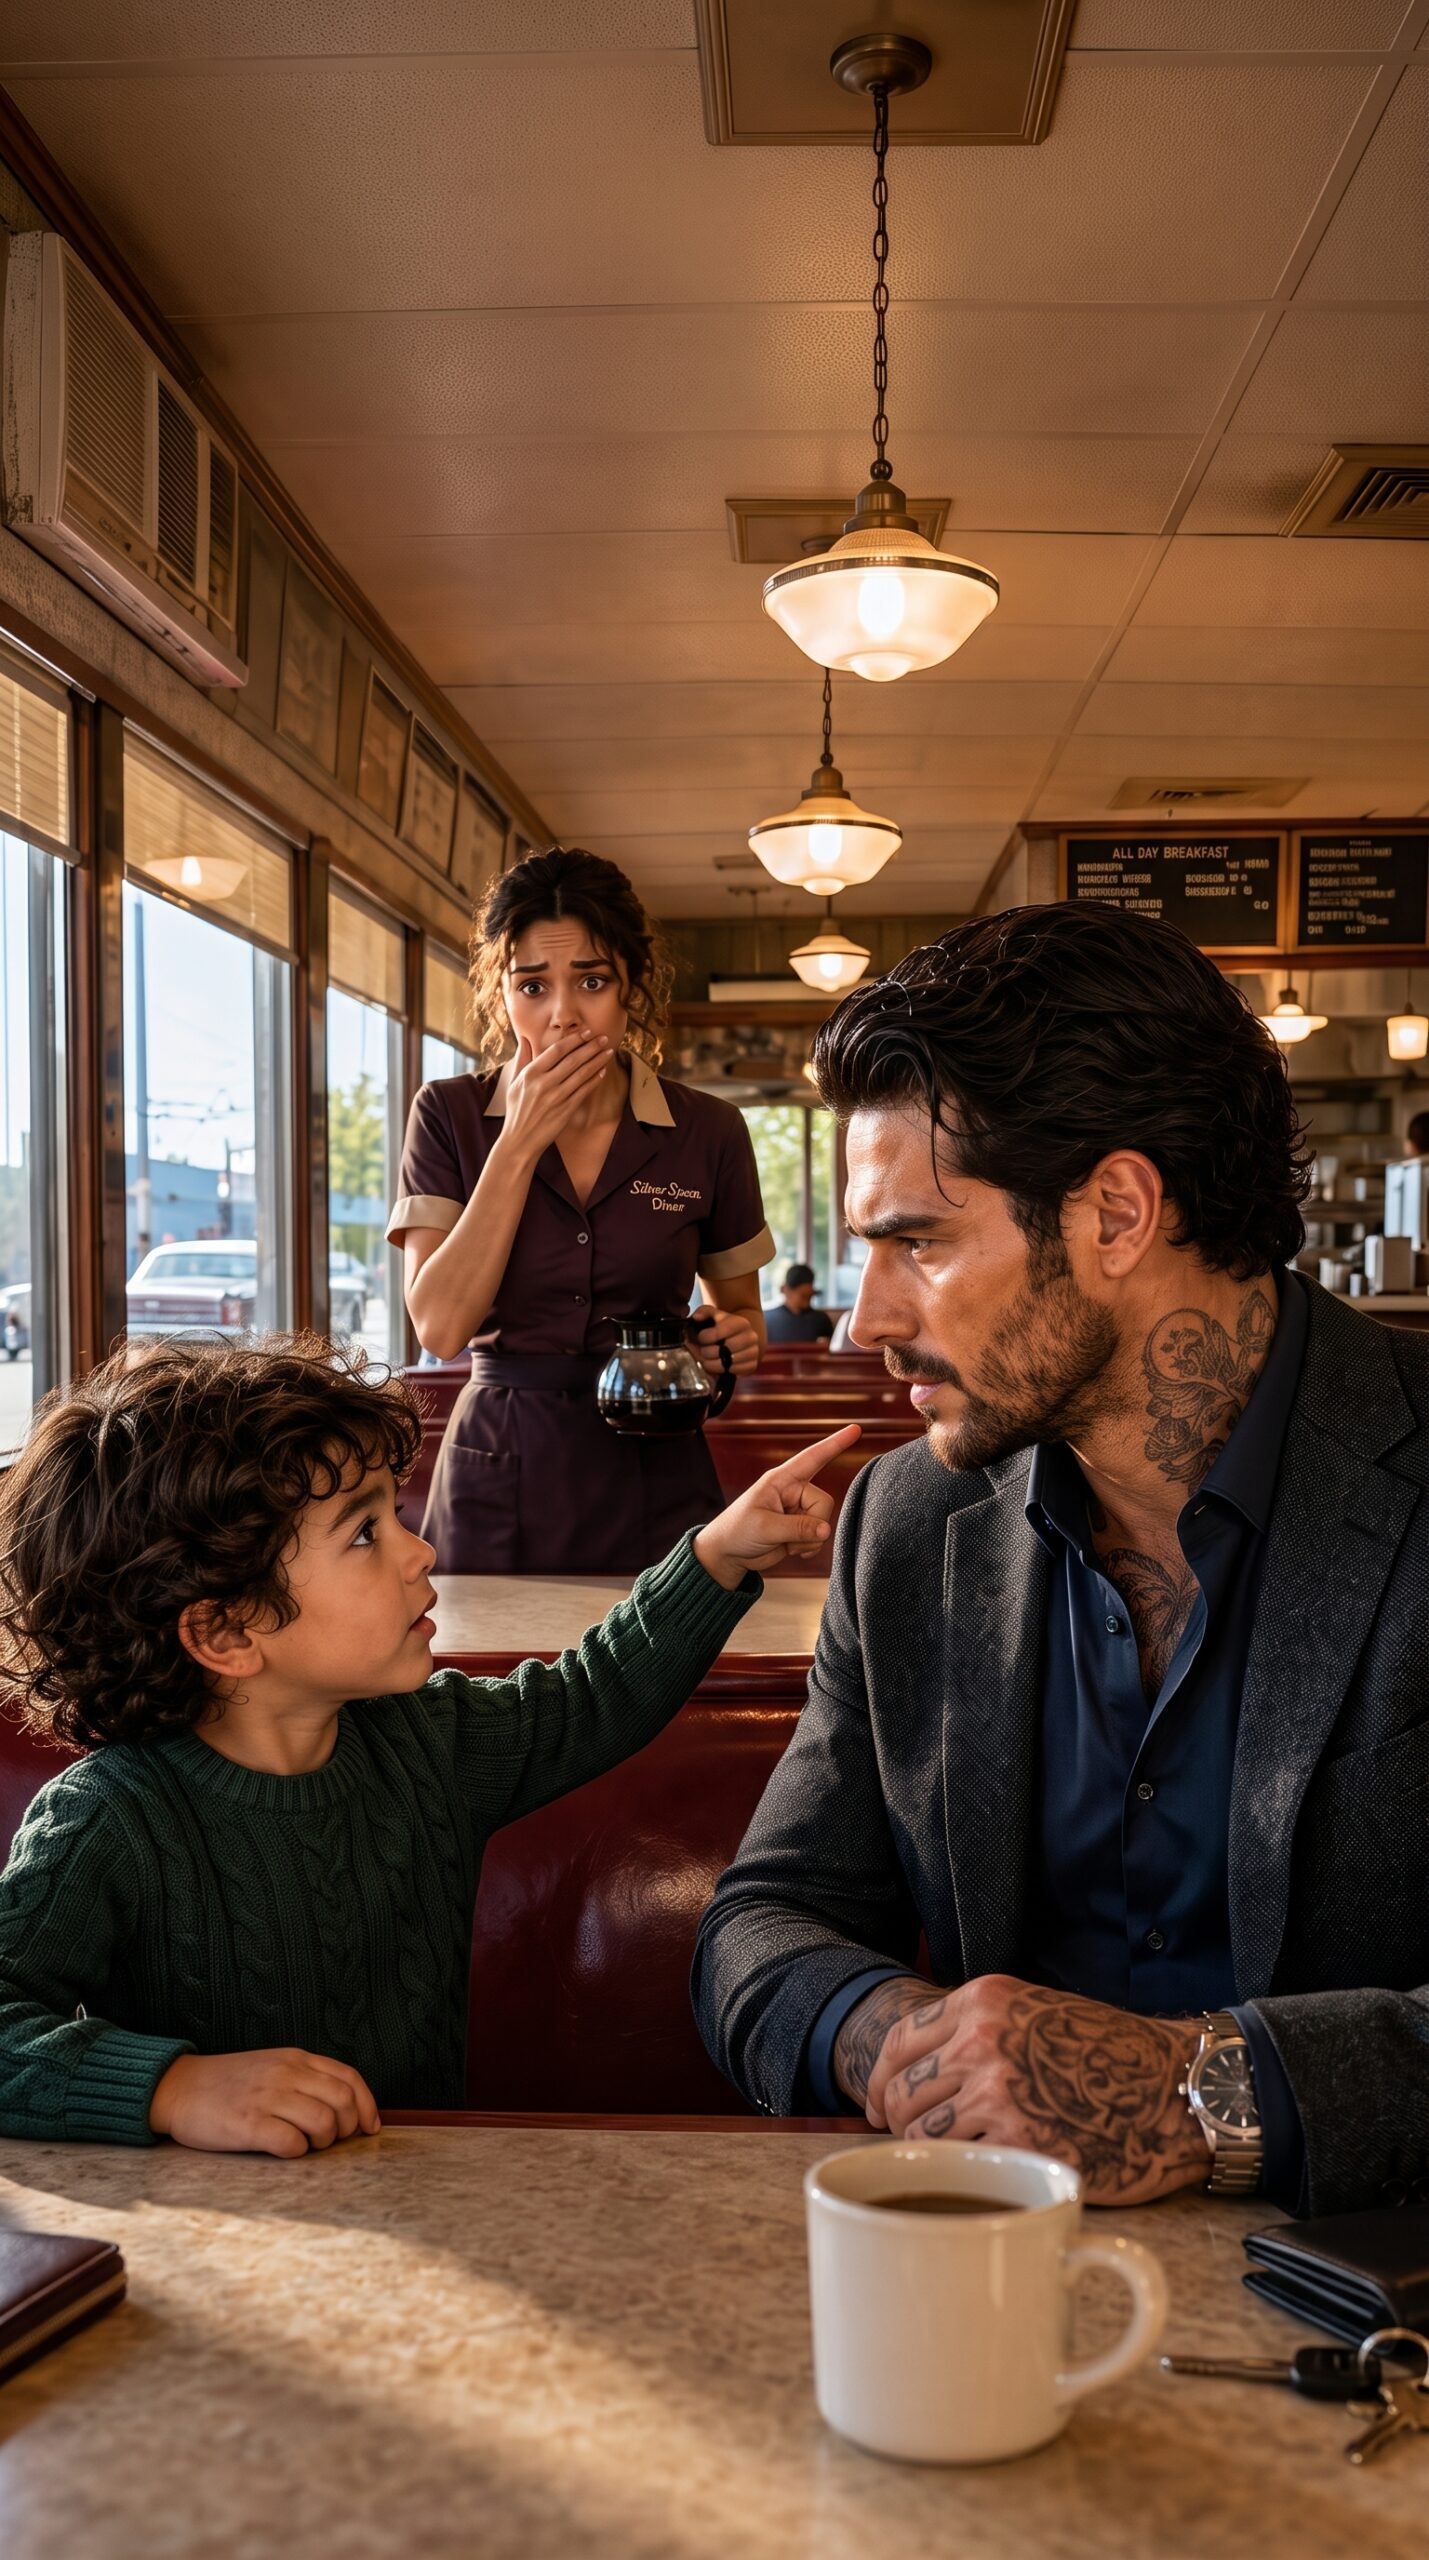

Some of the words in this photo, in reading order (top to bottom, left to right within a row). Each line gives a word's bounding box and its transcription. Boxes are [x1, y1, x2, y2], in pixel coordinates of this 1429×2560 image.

[1112, 847, 1134, 860] ALL
[1137, 847, 1159, 859] DAY
[1163, 845, 1230, 859] BREAKFAST
